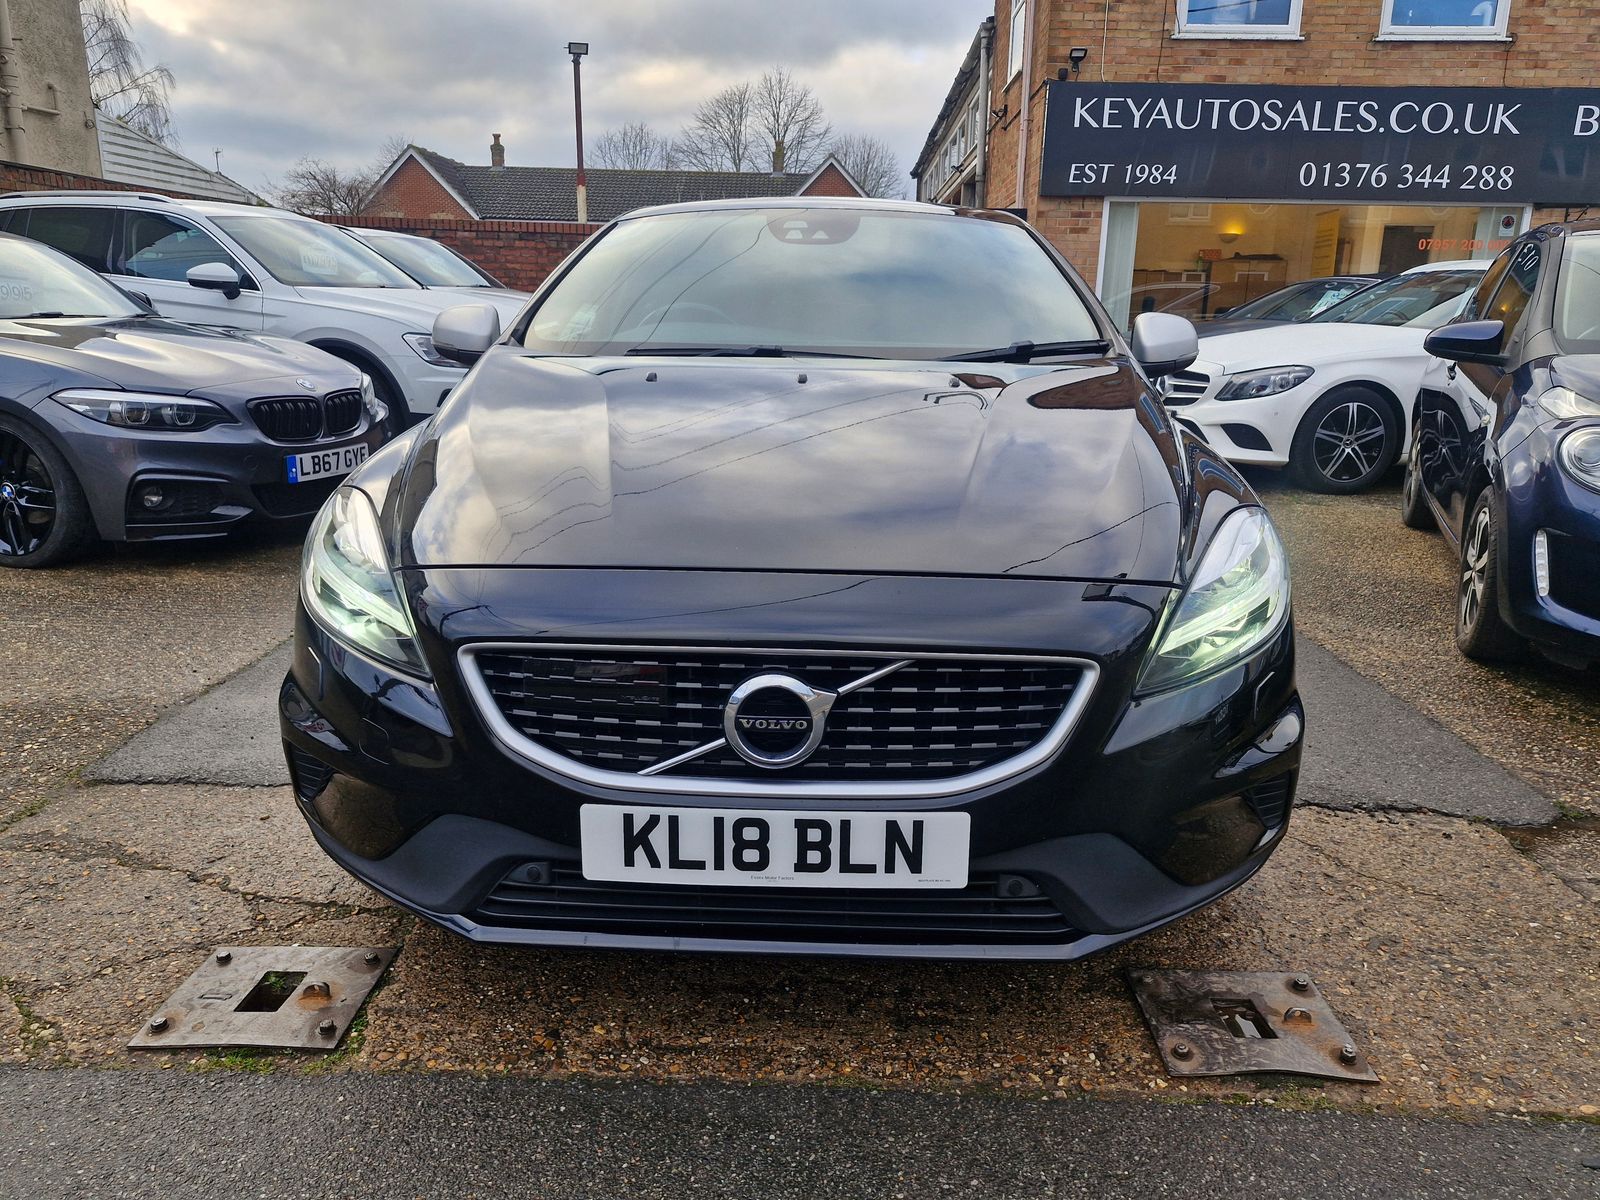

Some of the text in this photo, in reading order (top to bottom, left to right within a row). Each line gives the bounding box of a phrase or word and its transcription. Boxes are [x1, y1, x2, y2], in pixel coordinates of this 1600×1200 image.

[1073, 97, 1522, 135] KEYAUTOSALES.CO.UK
[1069, 163, 1177, 185] EST 1984
[1299, 162, 1515, 191] 01376 344 288
[300, 452, 341, 476] LB67
[739, 718, 808, 730] VOLVO
[623, 813, 924, 875] KL18 BLN
